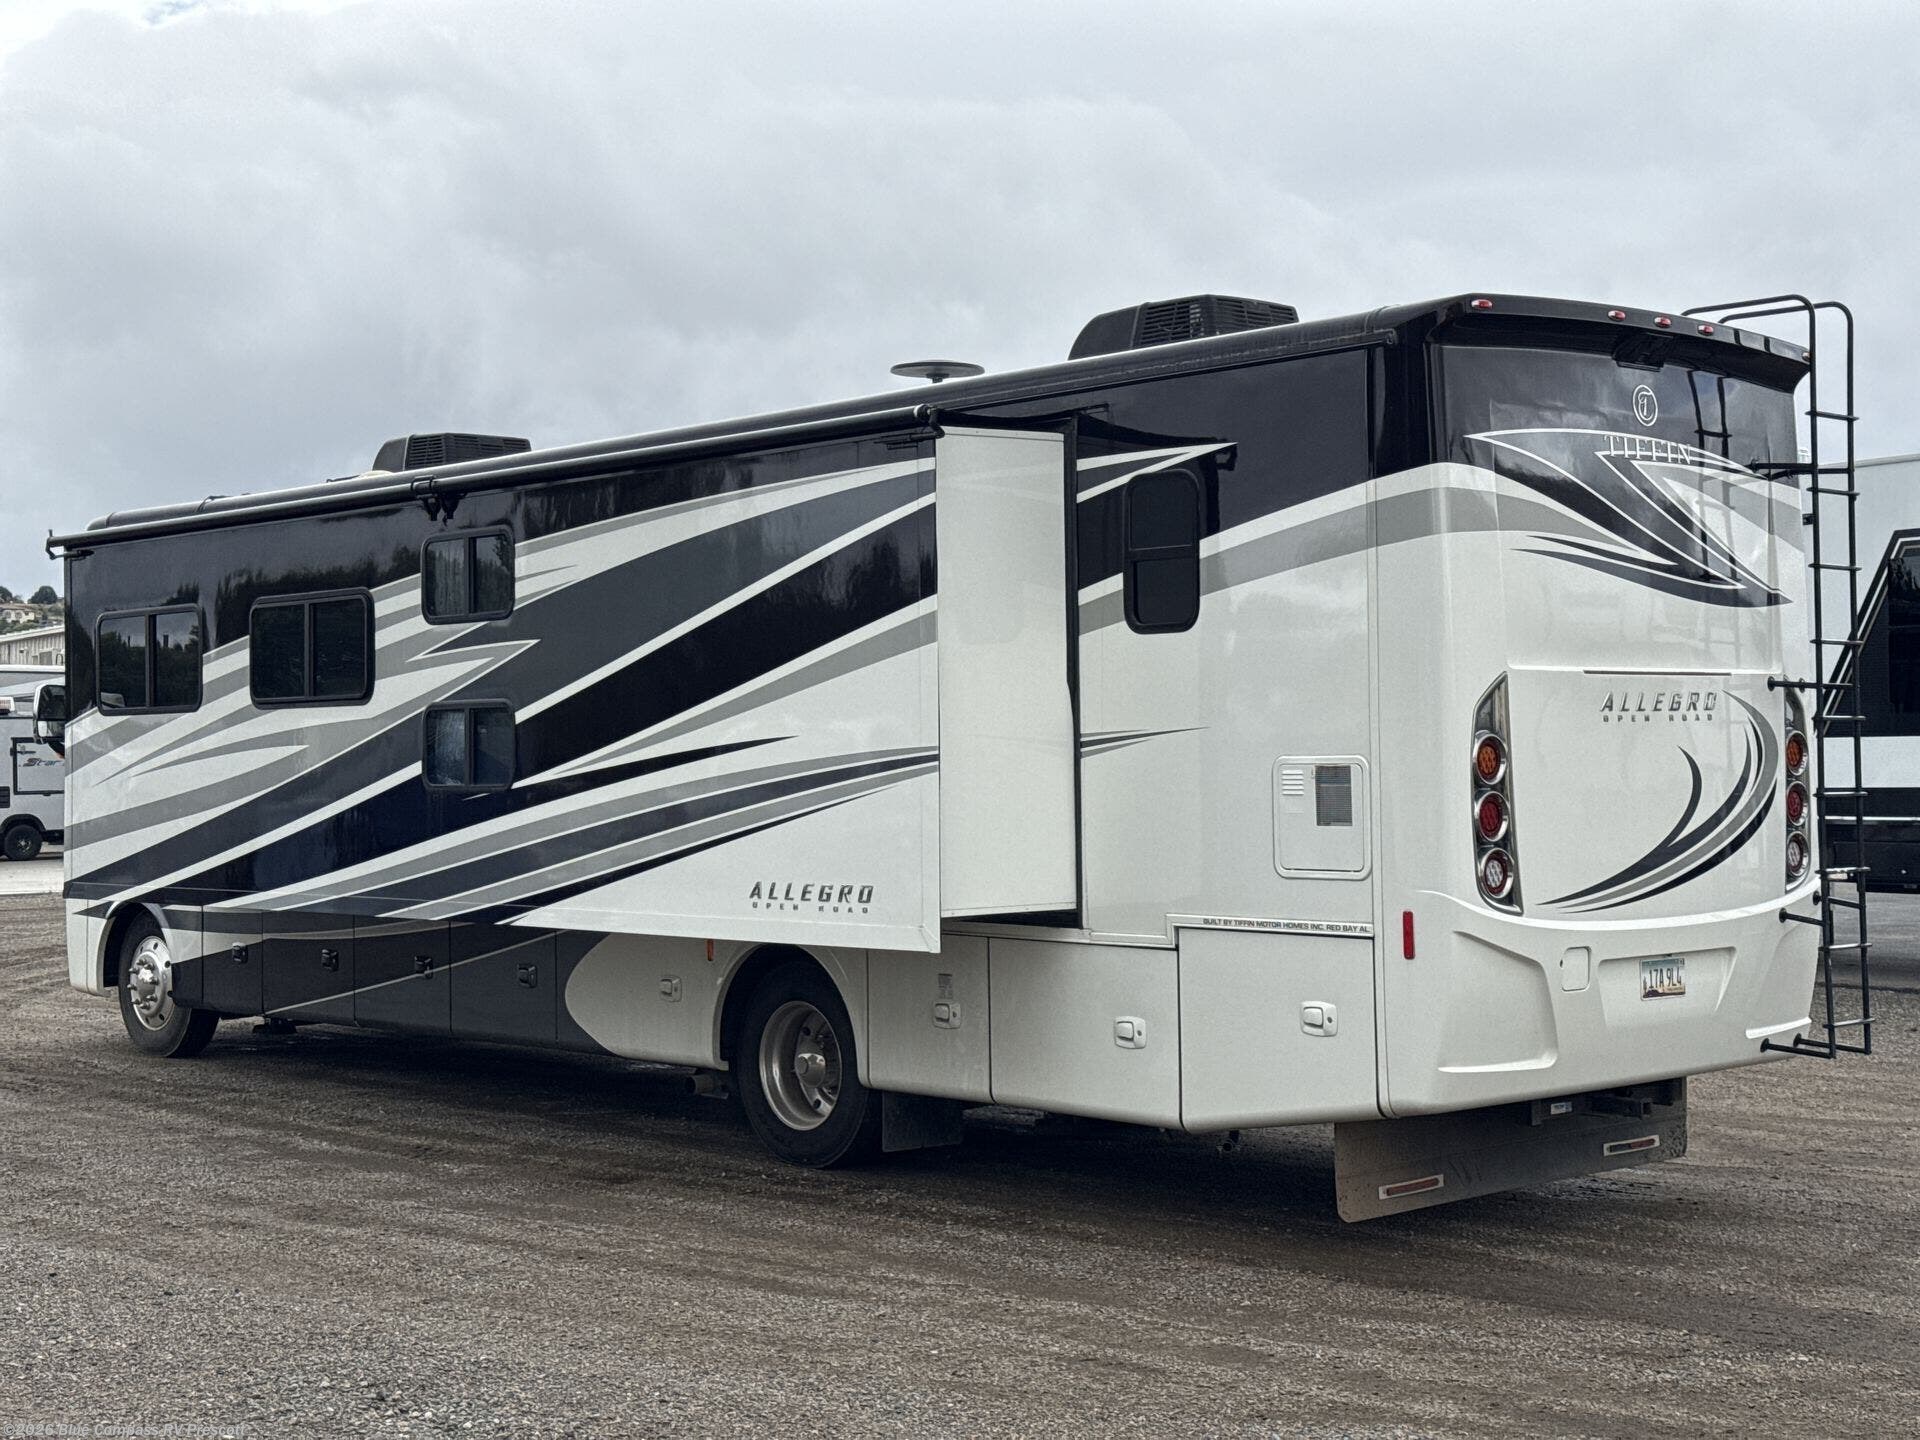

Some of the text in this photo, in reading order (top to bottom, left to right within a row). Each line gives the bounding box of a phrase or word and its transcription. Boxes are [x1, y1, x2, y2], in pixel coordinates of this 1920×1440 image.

[1603, 433, 1691, 465] TIFFIN
[1600, 691, 1718, 712] ALLEGRO
[749, 881, 874, 904] ALLEGRO
[1203, 918, 1221, 926] BUILT
[1234, 919, 1255, 927] TIFFIN
[1256, 920, 1281, 928] MOTOR
[1283, 921, 1309, 930] HOMES
